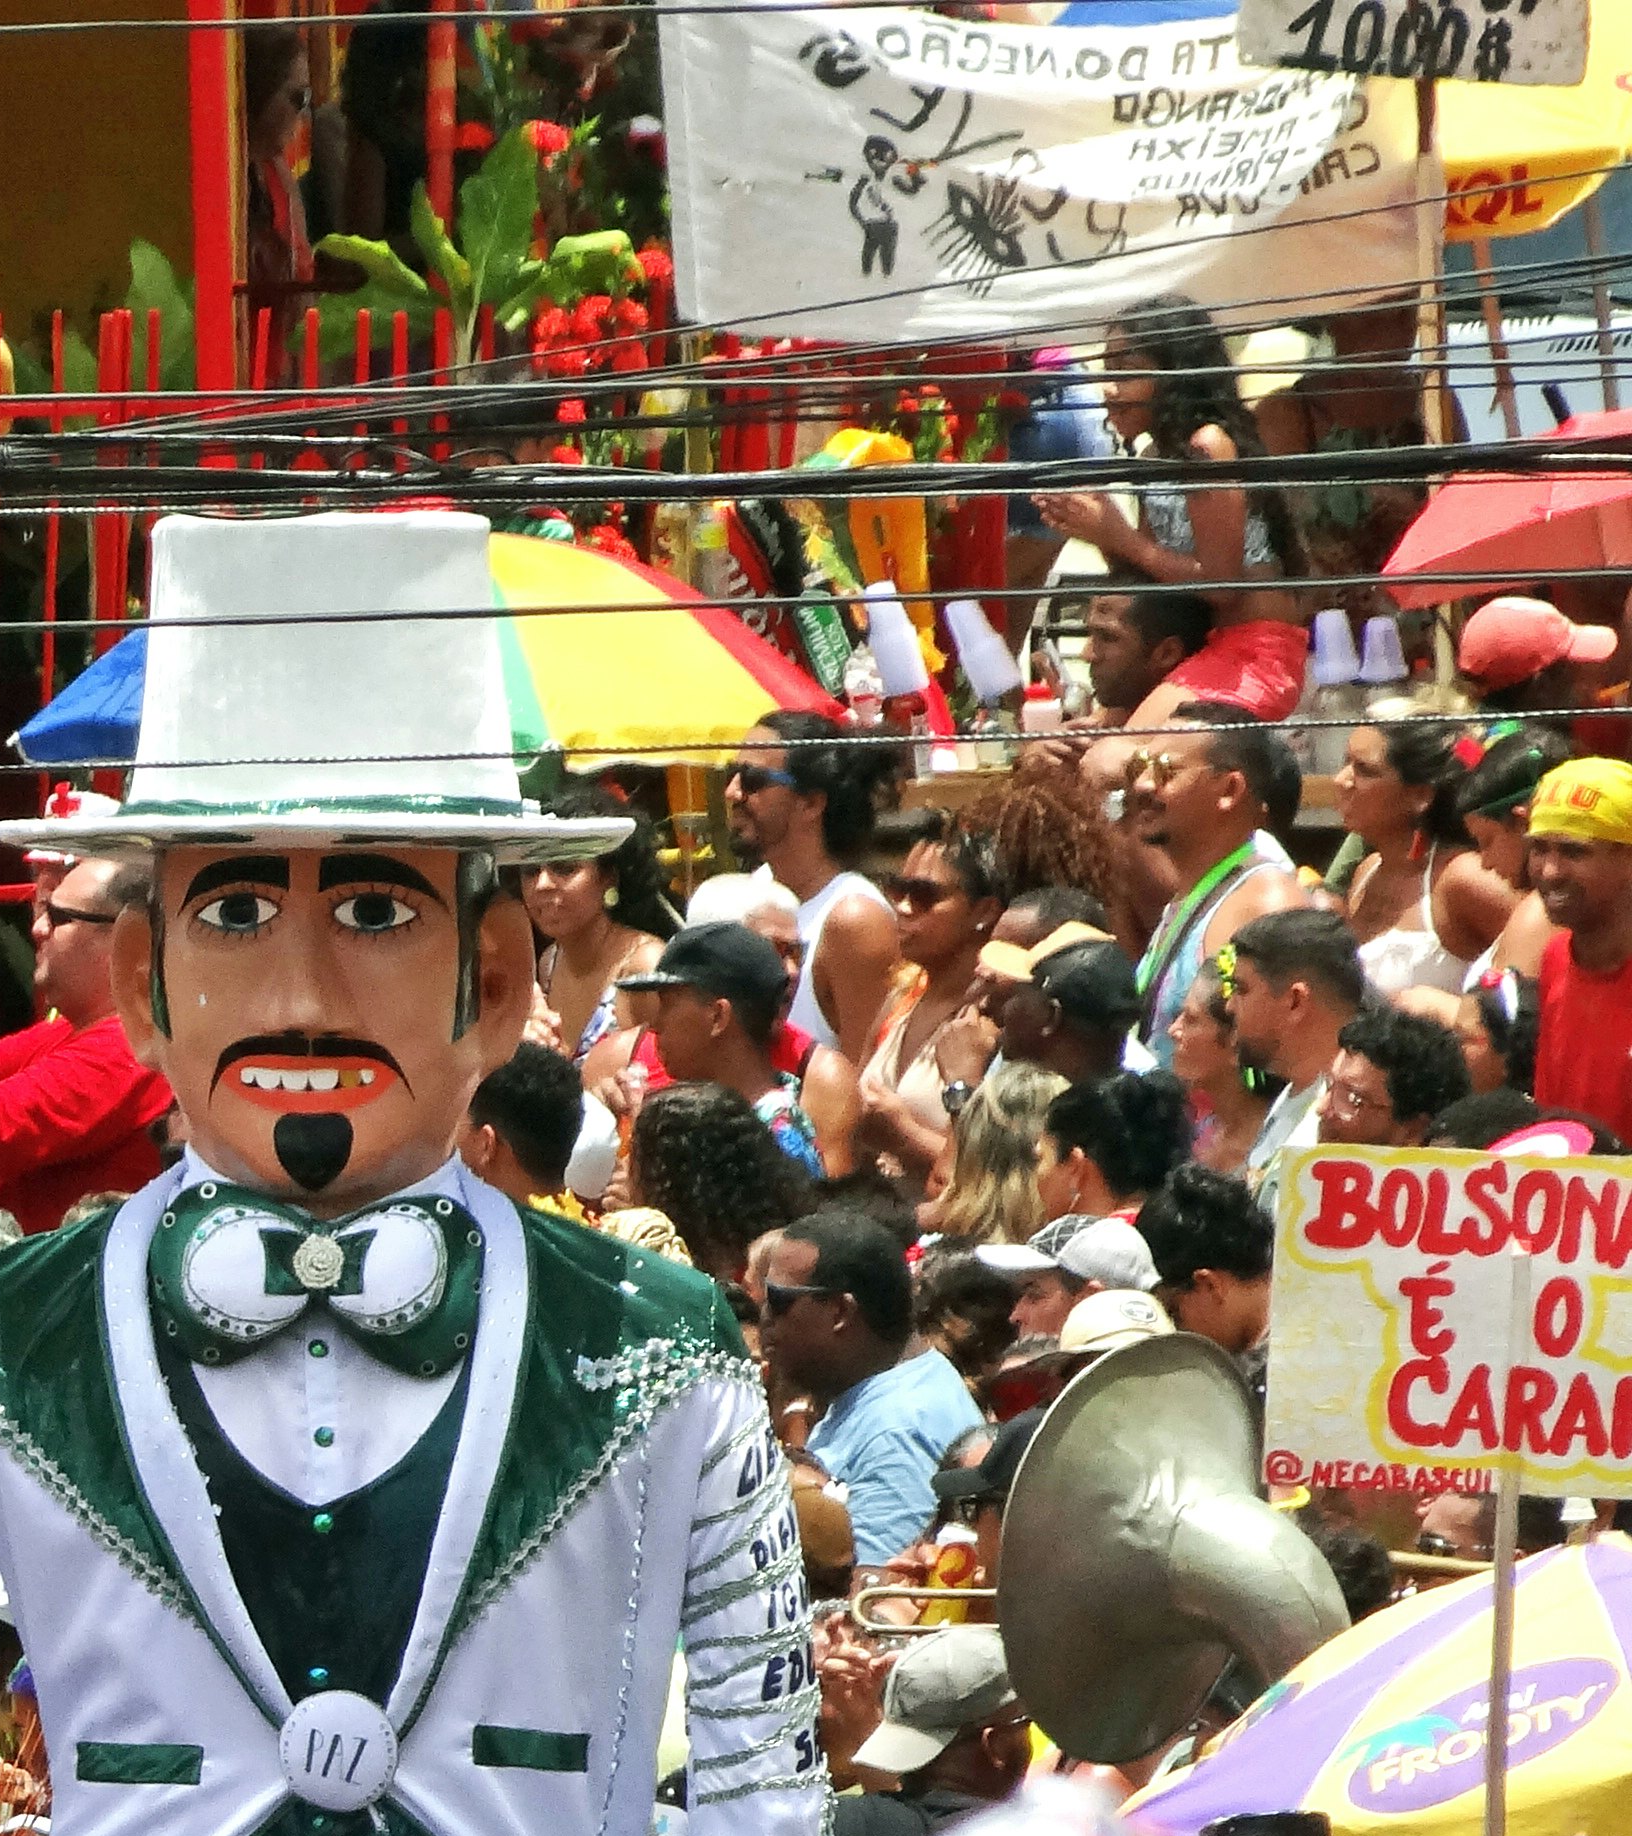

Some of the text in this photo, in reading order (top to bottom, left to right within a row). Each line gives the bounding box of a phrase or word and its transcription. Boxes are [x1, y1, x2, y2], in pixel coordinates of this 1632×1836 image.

[1398, 1260, 1584, 1359] É O
[305, 1727, 368, 1785] PAZ
